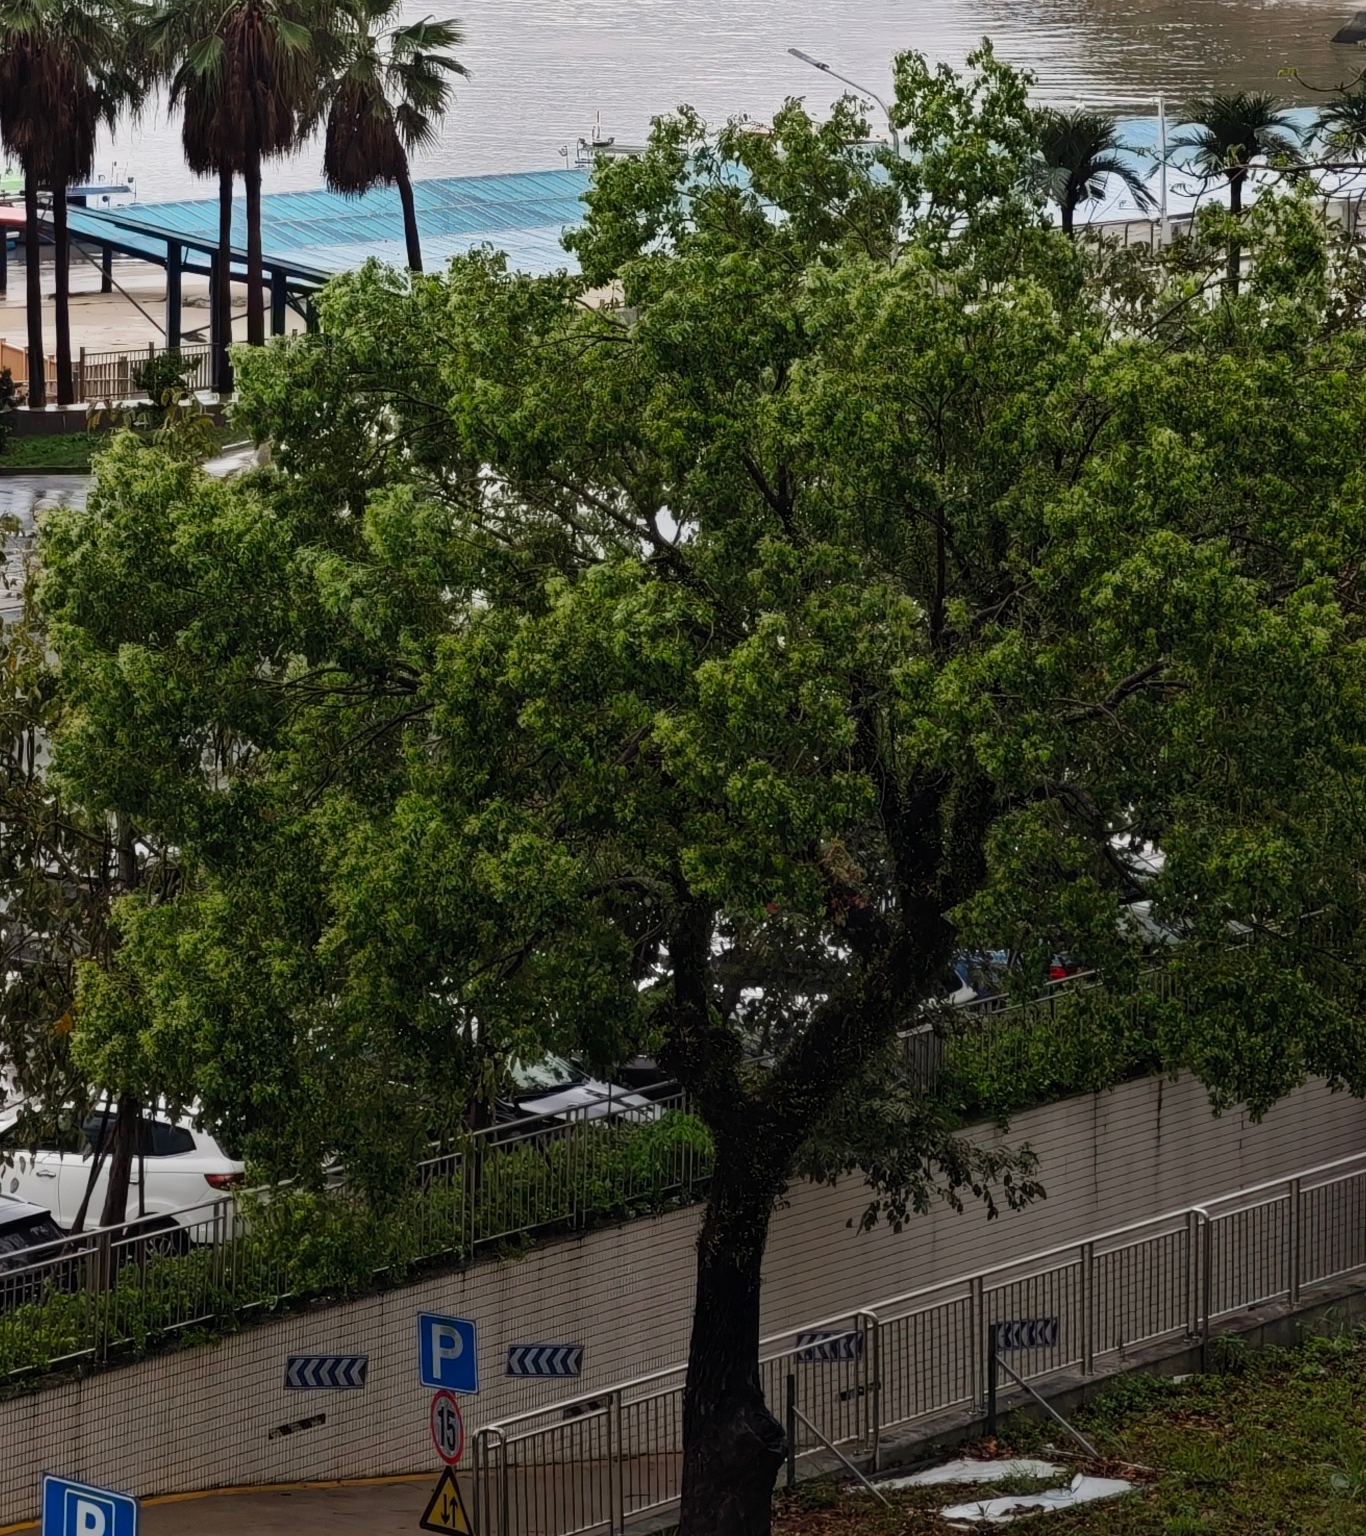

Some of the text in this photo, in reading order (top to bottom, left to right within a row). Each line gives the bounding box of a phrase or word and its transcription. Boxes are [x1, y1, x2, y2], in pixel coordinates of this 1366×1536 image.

[431, 1323, 464, 1380] P
[437, 1406, 456, 1452] 15
[76, 1499, 106, 1536] P
